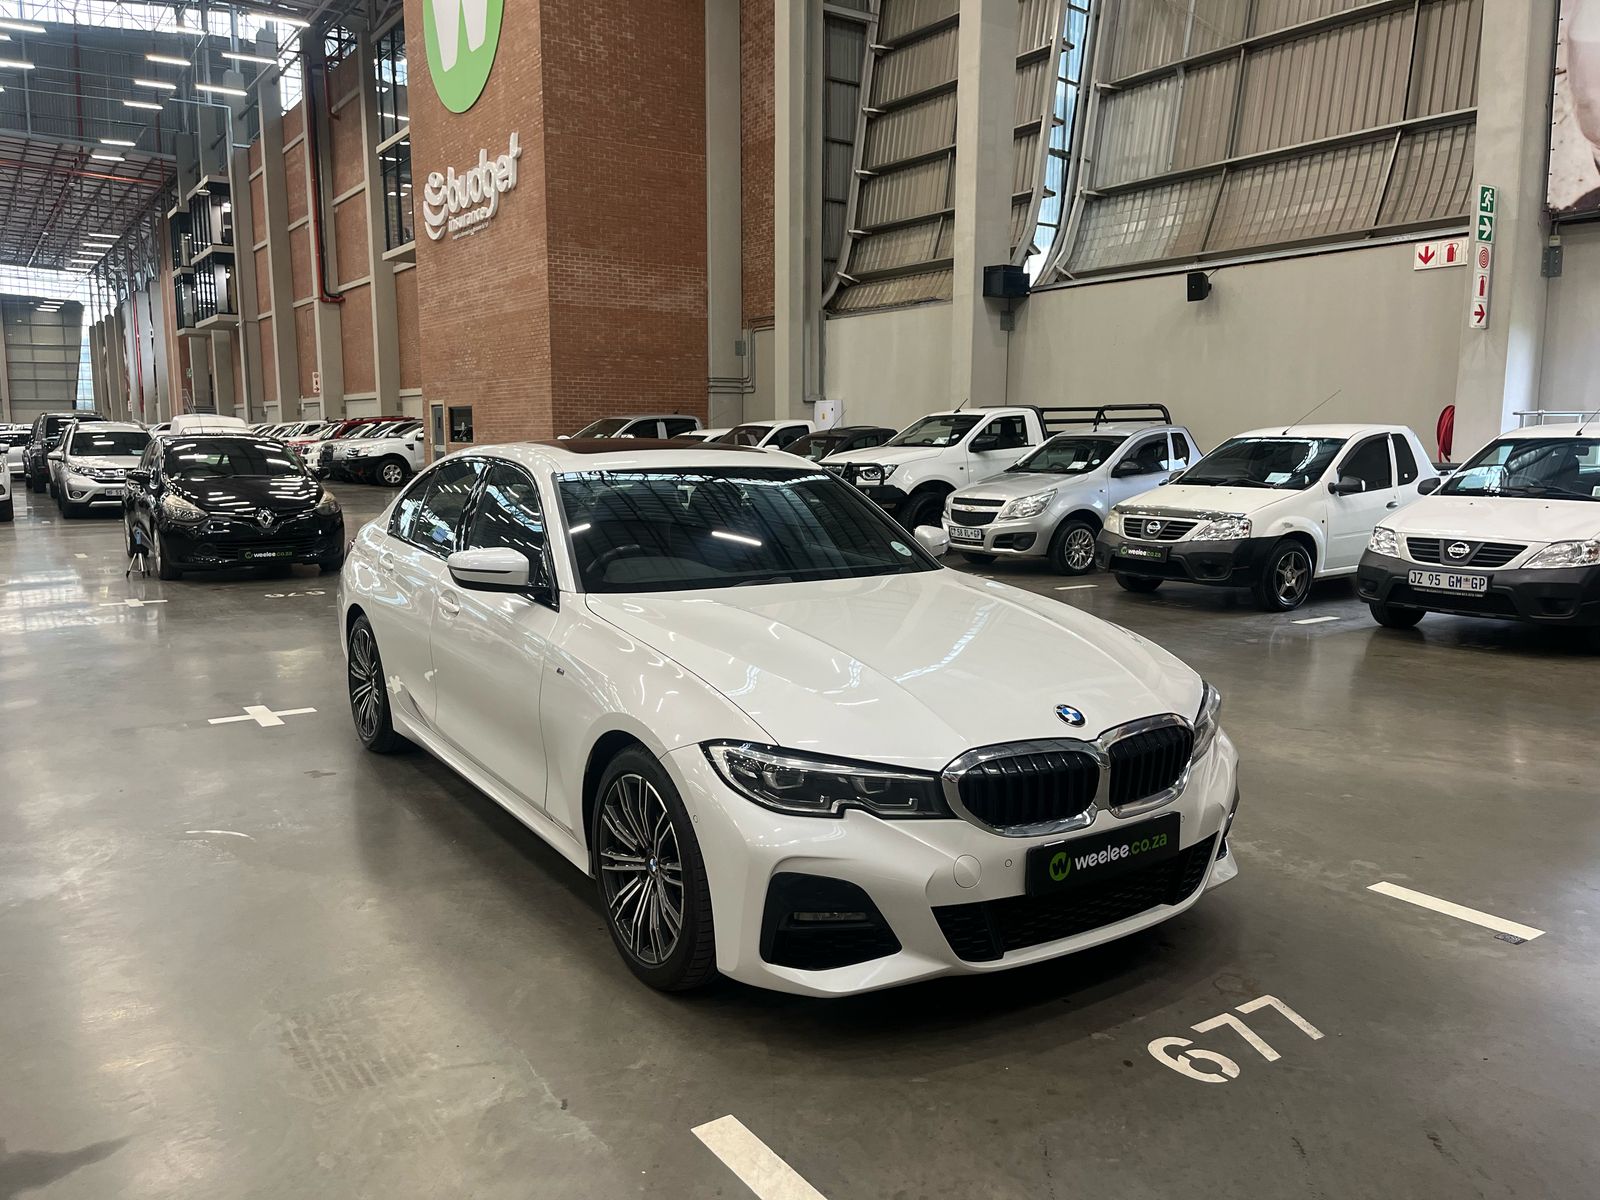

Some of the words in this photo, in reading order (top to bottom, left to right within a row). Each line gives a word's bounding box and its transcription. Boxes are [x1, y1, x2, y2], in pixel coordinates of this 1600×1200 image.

[447, 132, 522, 218] budget
[1410, 572, 1423, 584] JZ
[1428, 573, 1441, 586] 95
[1448, 575, 1463, 589] GM
[1471, 577, 1486, 590] GP
[1075, 833, 1168, 871] weelee.co.za
[1147, 994, 1326, 1083] 677
